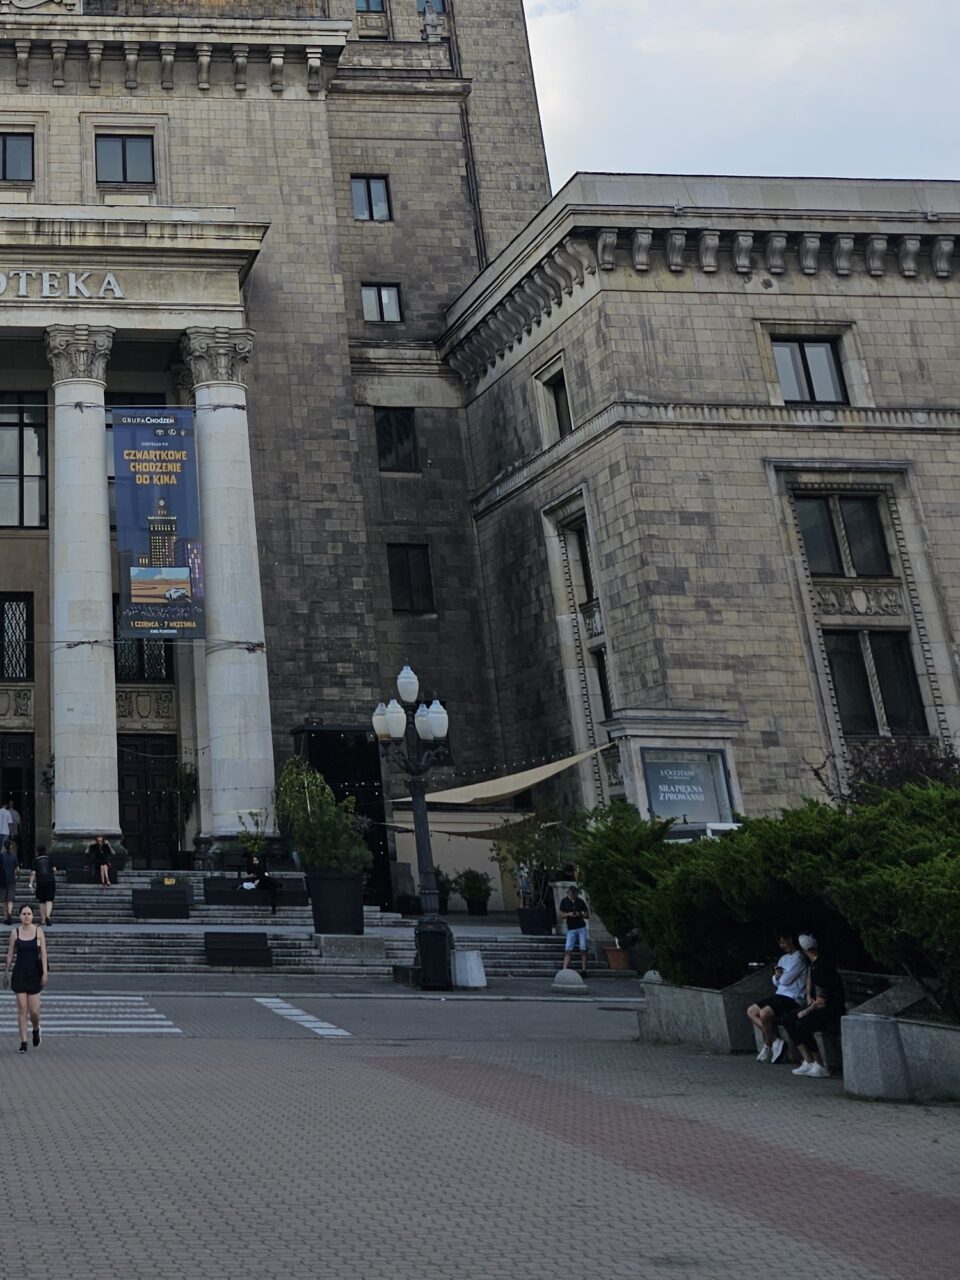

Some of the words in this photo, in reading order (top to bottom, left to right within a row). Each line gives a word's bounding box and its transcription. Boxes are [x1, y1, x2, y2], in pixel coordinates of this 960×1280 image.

[123, 450, 188, 461] CZWARTKOWE
[130, 462, 182, 473] CHODZENIE
[136, 474, 150, 485] DO
[153, 475, 177, 485] KINA
